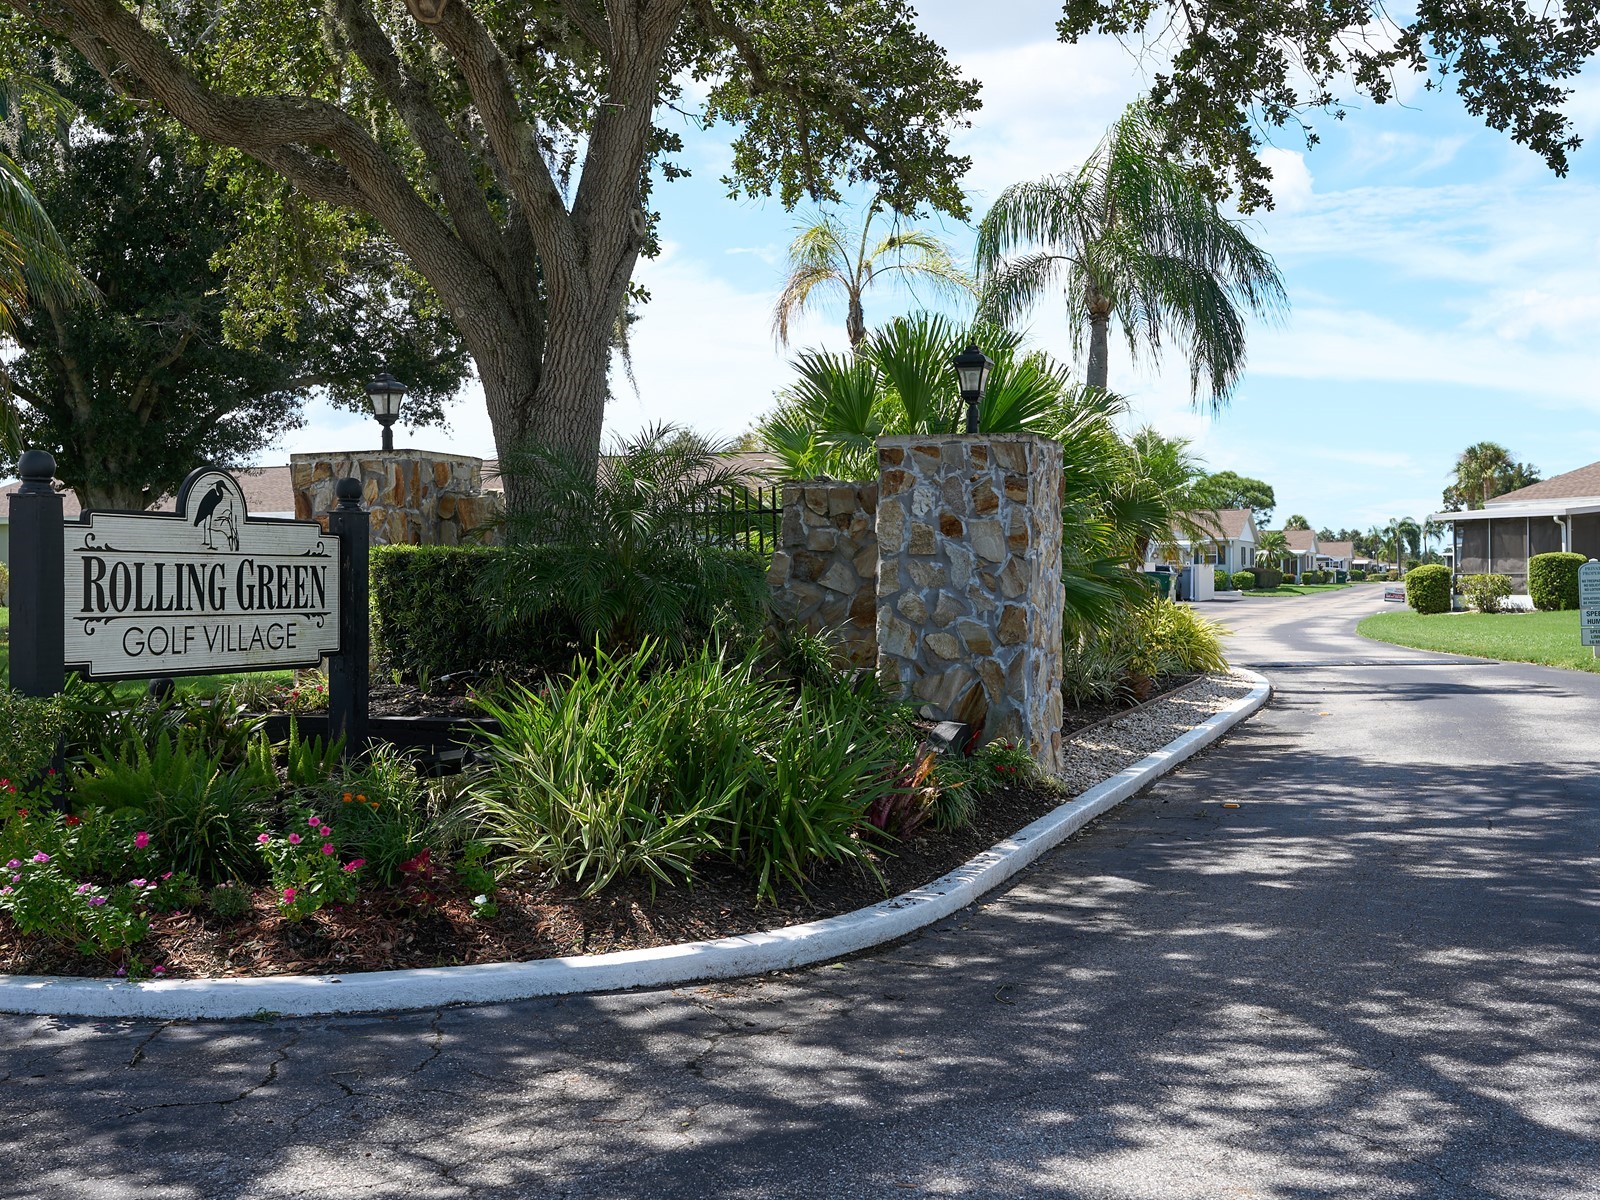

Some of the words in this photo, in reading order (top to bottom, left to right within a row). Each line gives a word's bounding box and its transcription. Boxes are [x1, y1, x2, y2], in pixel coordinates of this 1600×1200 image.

[80, 555, 227, 613] ROLLING
[236, 558, 327, 611] GREEN
[122, 625, 195, 657] GOLF
[203, 622, 297, 653] VILLAGE
